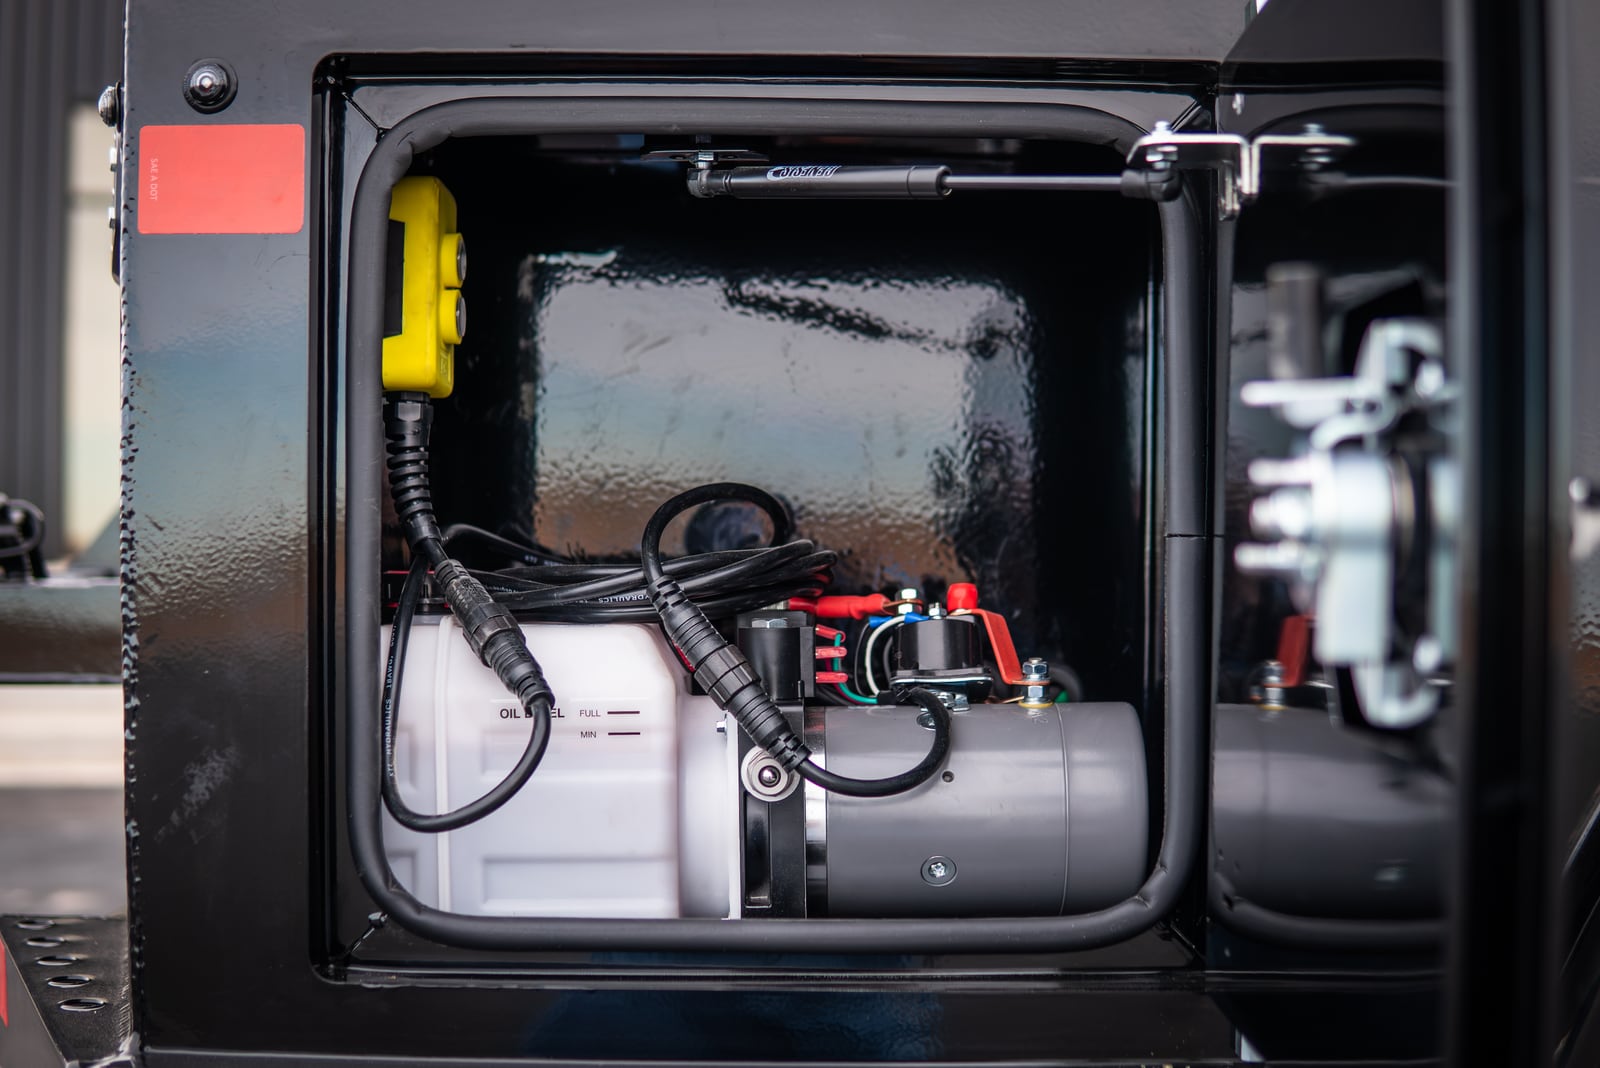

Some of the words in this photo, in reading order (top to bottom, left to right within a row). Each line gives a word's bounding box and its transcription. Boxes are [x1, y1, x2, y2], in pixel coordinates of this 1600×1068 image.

[150, 158, 159, 173] SAE
[150, 183, 159, 200] DOT
[598, 594, 650, 603] YDRAULICS
[499, 708, 520, 719] OIL
[579, 709, 601, 718] FULL
[580, 731, 597, 739] MIN
